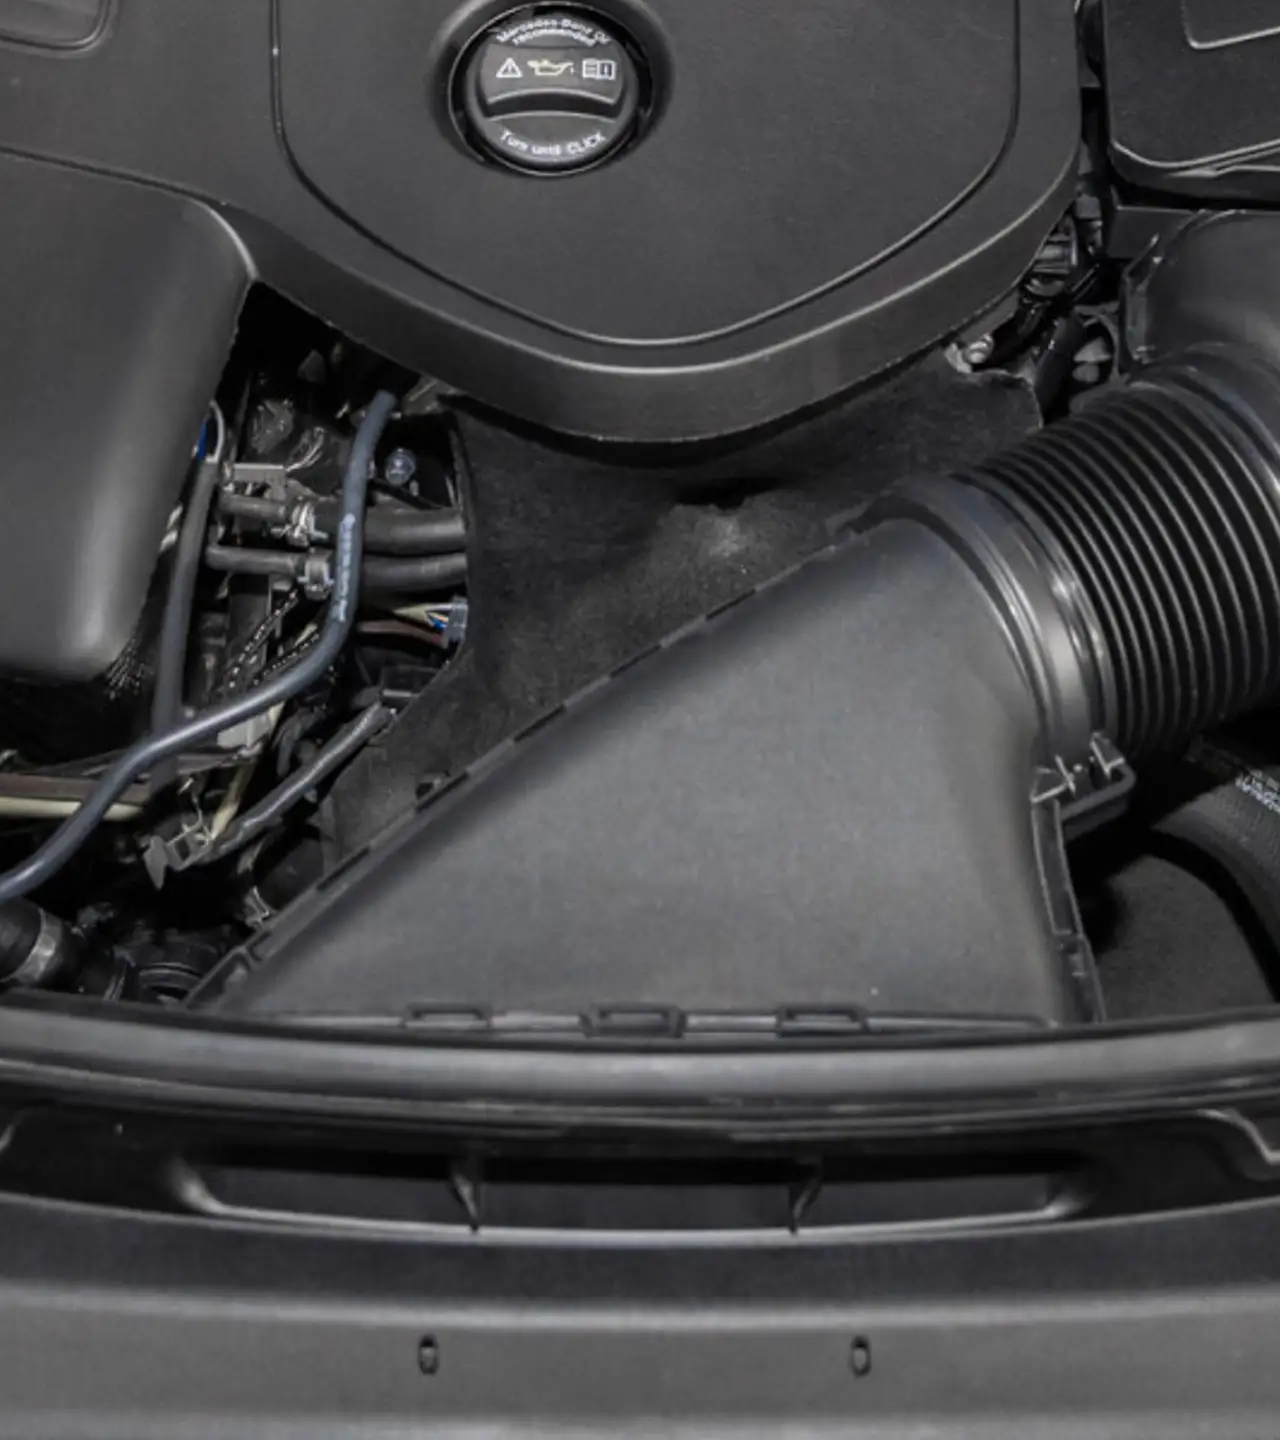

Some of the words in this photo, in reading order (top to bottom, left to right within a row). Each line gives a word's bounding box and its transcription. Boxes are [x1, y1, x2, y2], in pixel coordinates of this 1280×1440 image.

[500, 128, 529, 152] Turn
[531, 143, 562, 155] until
[566, 130, 607, 154] CLICK
